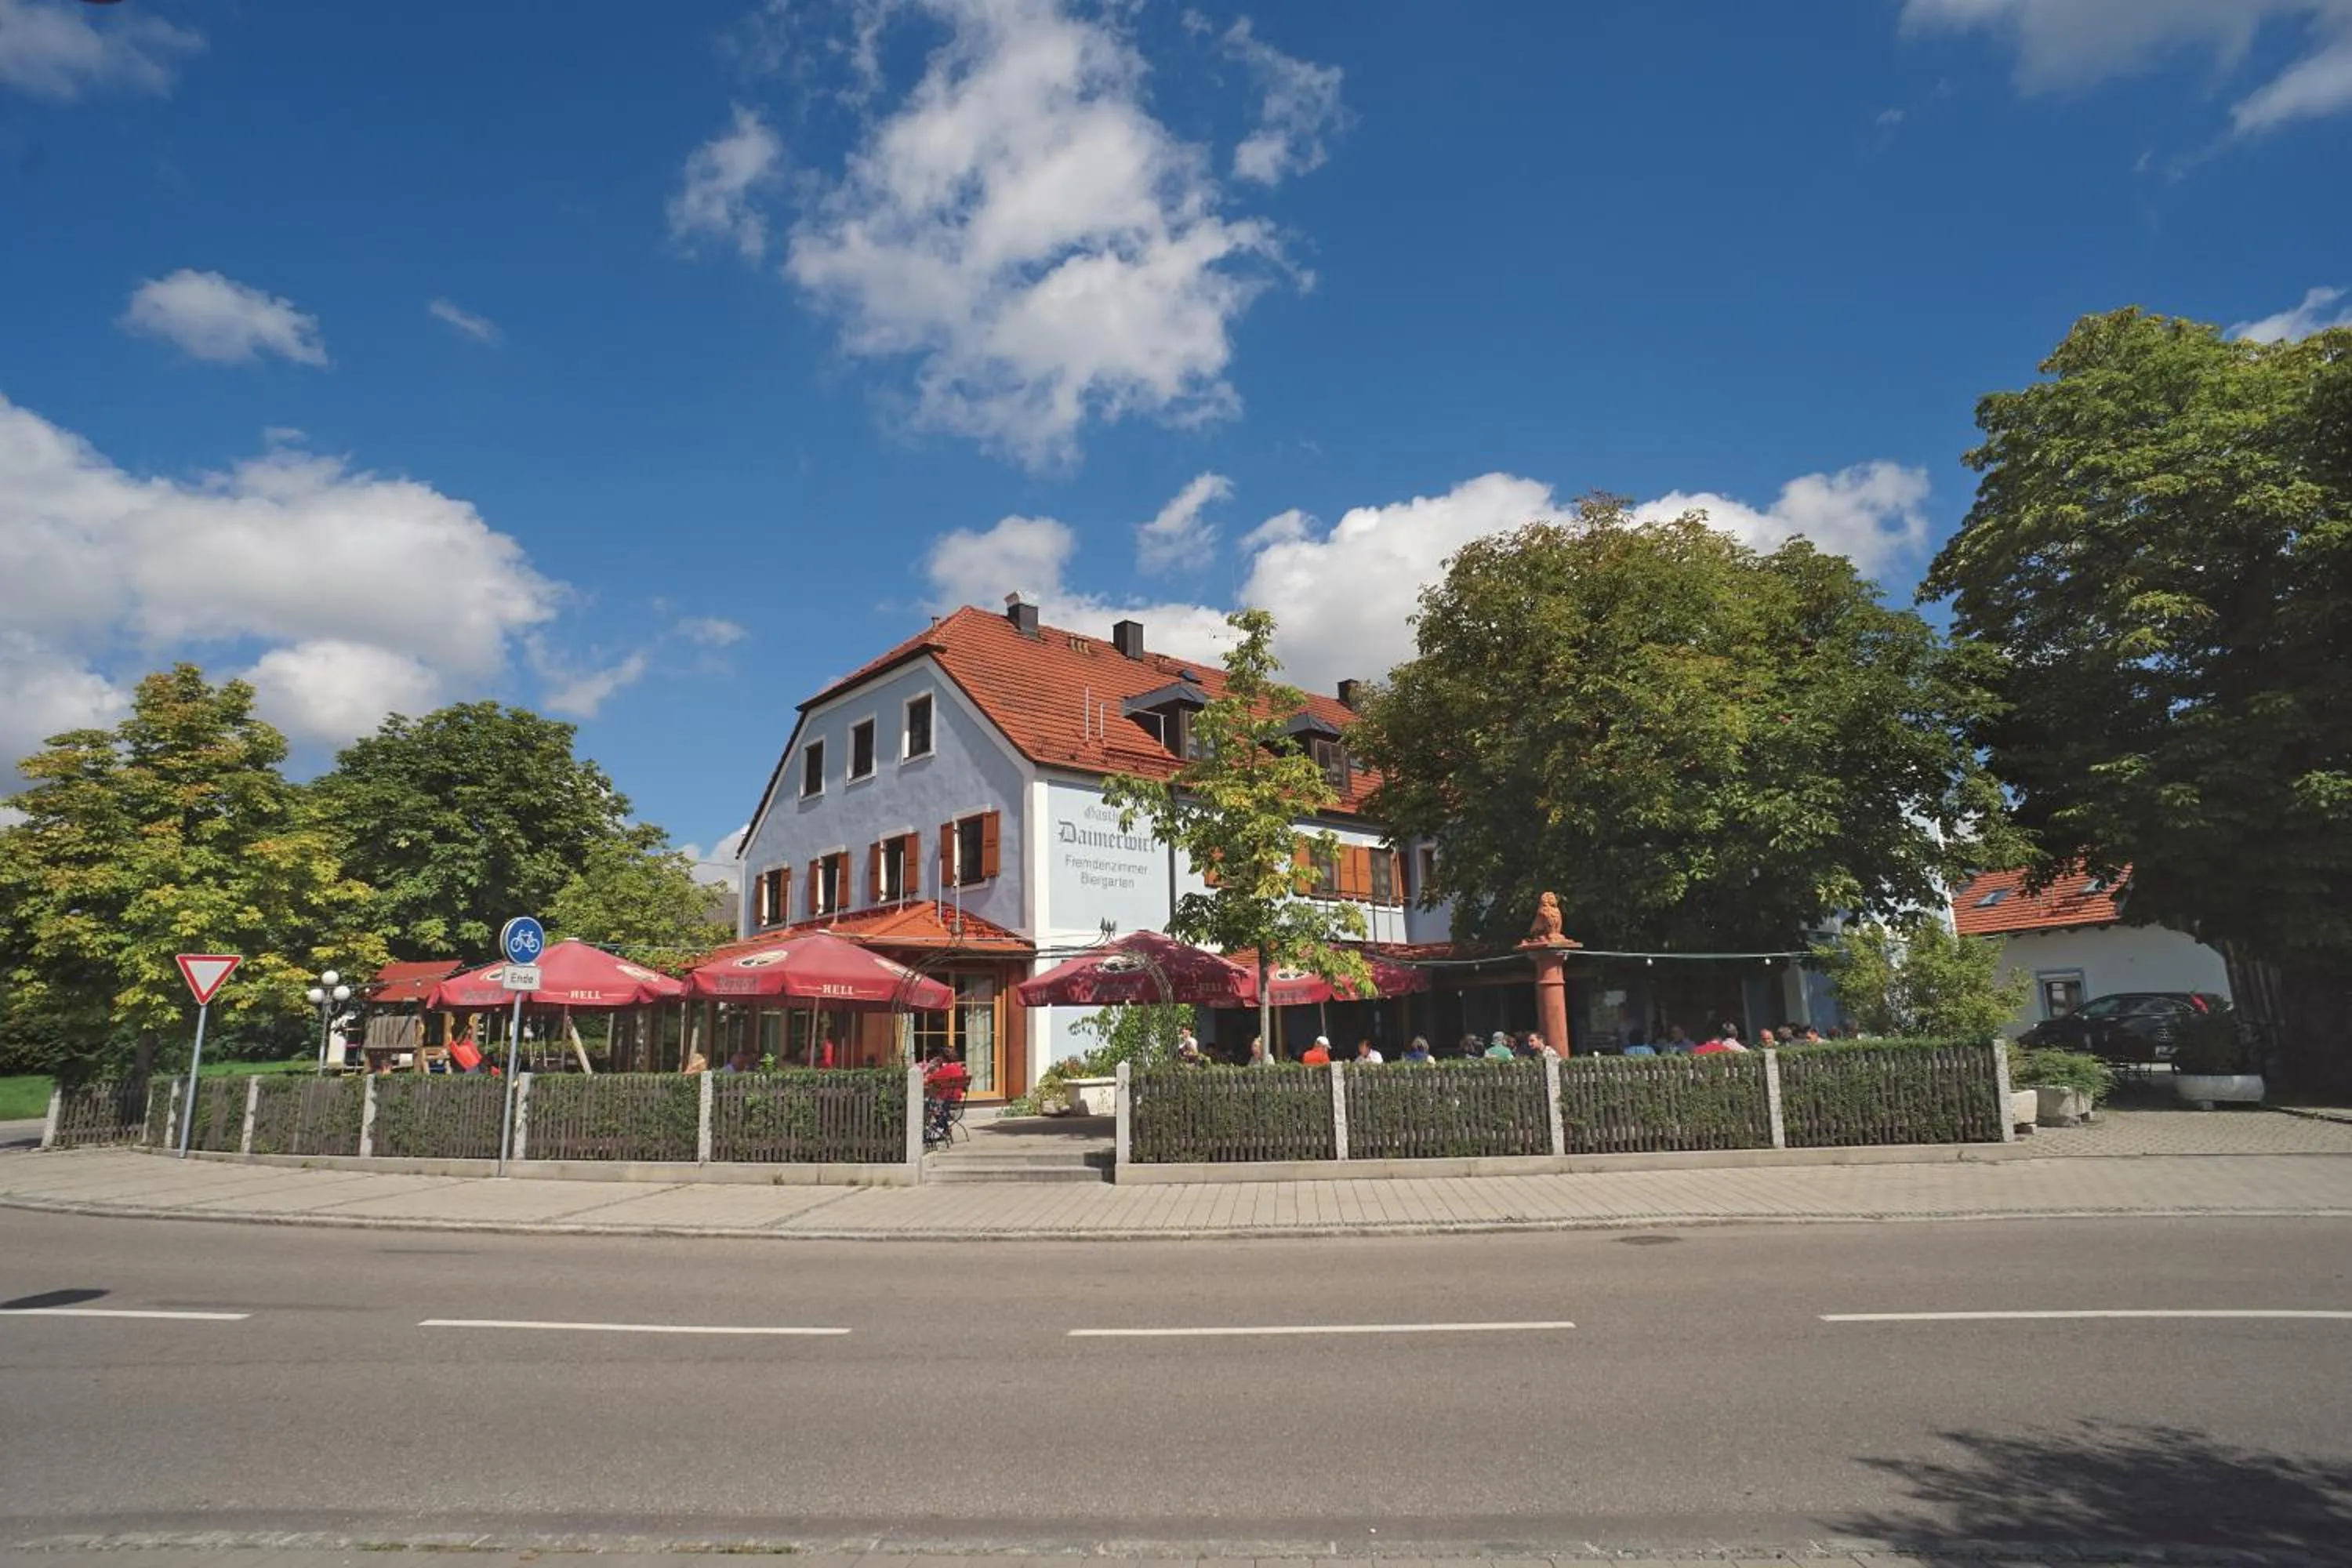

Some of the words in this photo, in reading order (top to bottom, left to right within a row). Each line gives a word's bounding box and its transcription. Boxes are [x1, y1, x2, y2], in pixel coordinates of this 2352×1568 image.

[1083, 804, 1127, 823] Gasth
[1065, 854, 1148, 875] Fremdenzimmer
[1080, 872, 1134, 889] Biergarten
[510, 972, 534, 984] Ende
[570, 990, 601, 1000] HELL
[822, 984, 854, 996] HELL
